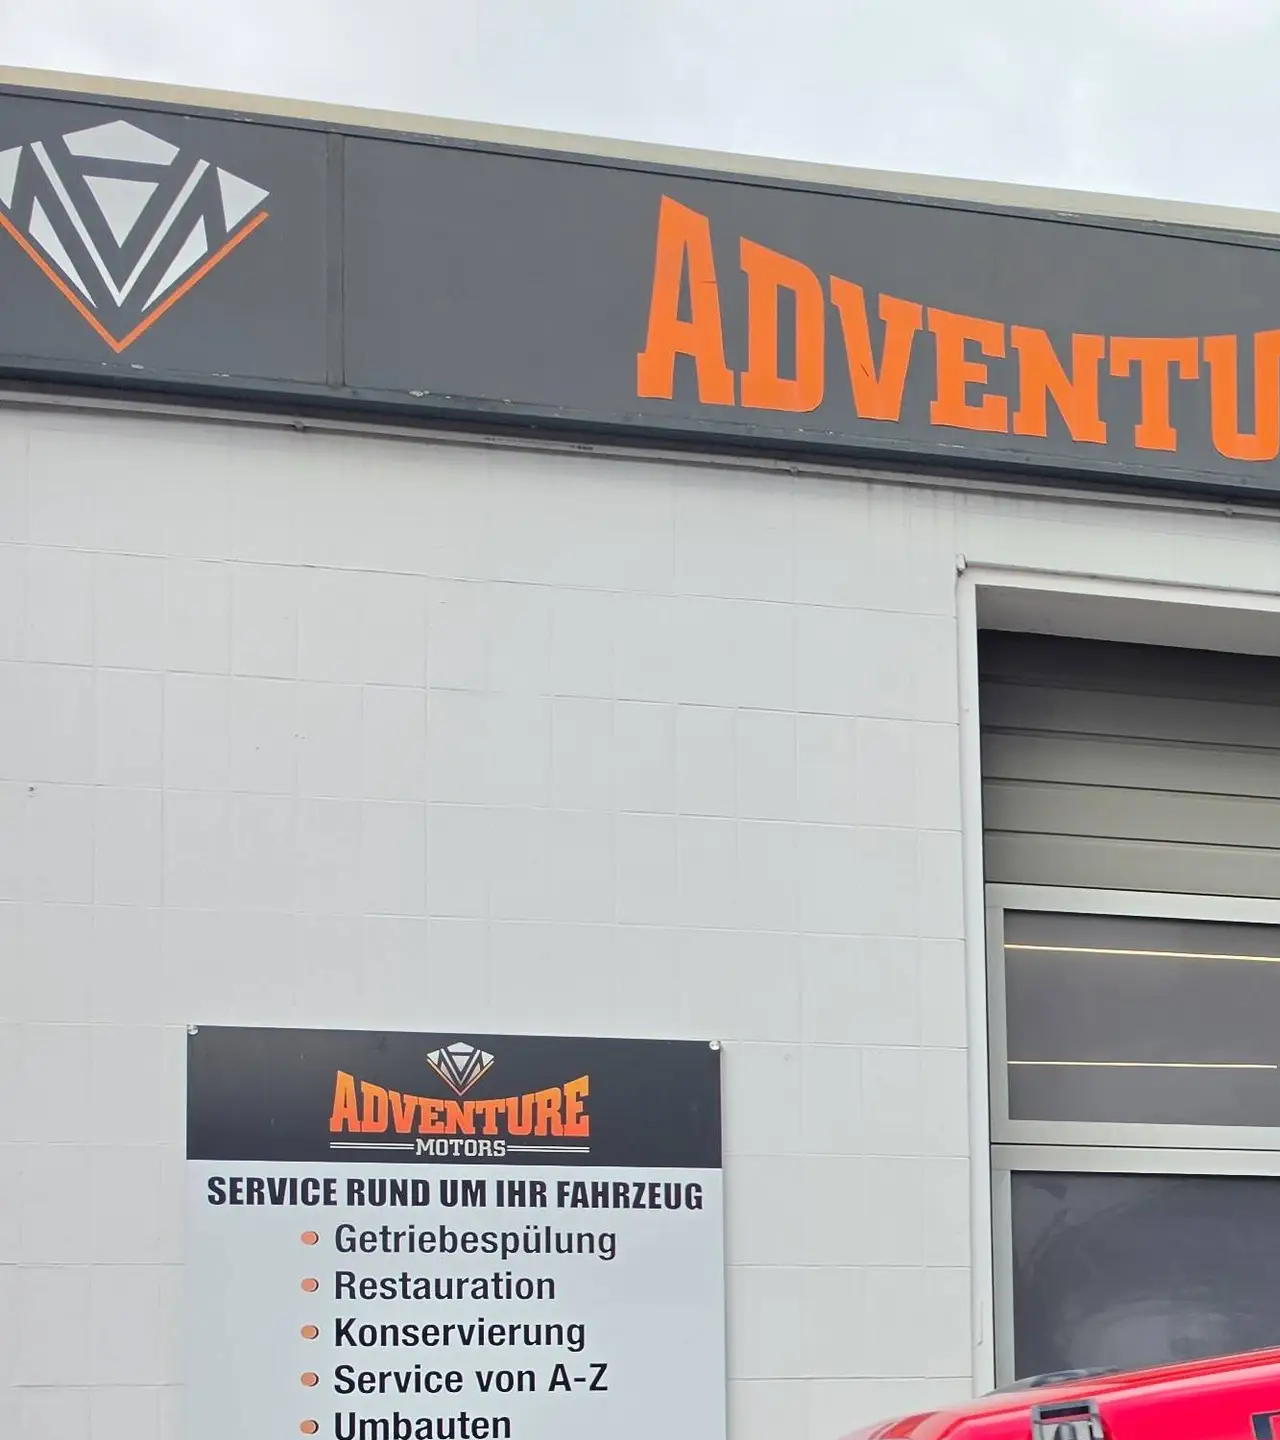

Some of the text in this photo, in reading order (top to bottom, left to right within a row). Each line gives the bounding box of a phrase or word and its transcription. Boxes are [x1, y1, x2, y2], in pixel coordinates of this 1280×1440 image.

[329, 1070, 590, 1137] ADVENTURE
[415, 1138, 506, 1157] MOTORS
[207, 1176, 703, 1210] SERVICE RUND UM IHR FAHRZEUG
[335, 1223, 617, 1261] Getriebespülung
[335, 1271, 555, 1300] Restauration
[335, 1317, 586, 1353] Konservierung
[334, 1363, 608, 1395] Service von A-Z
